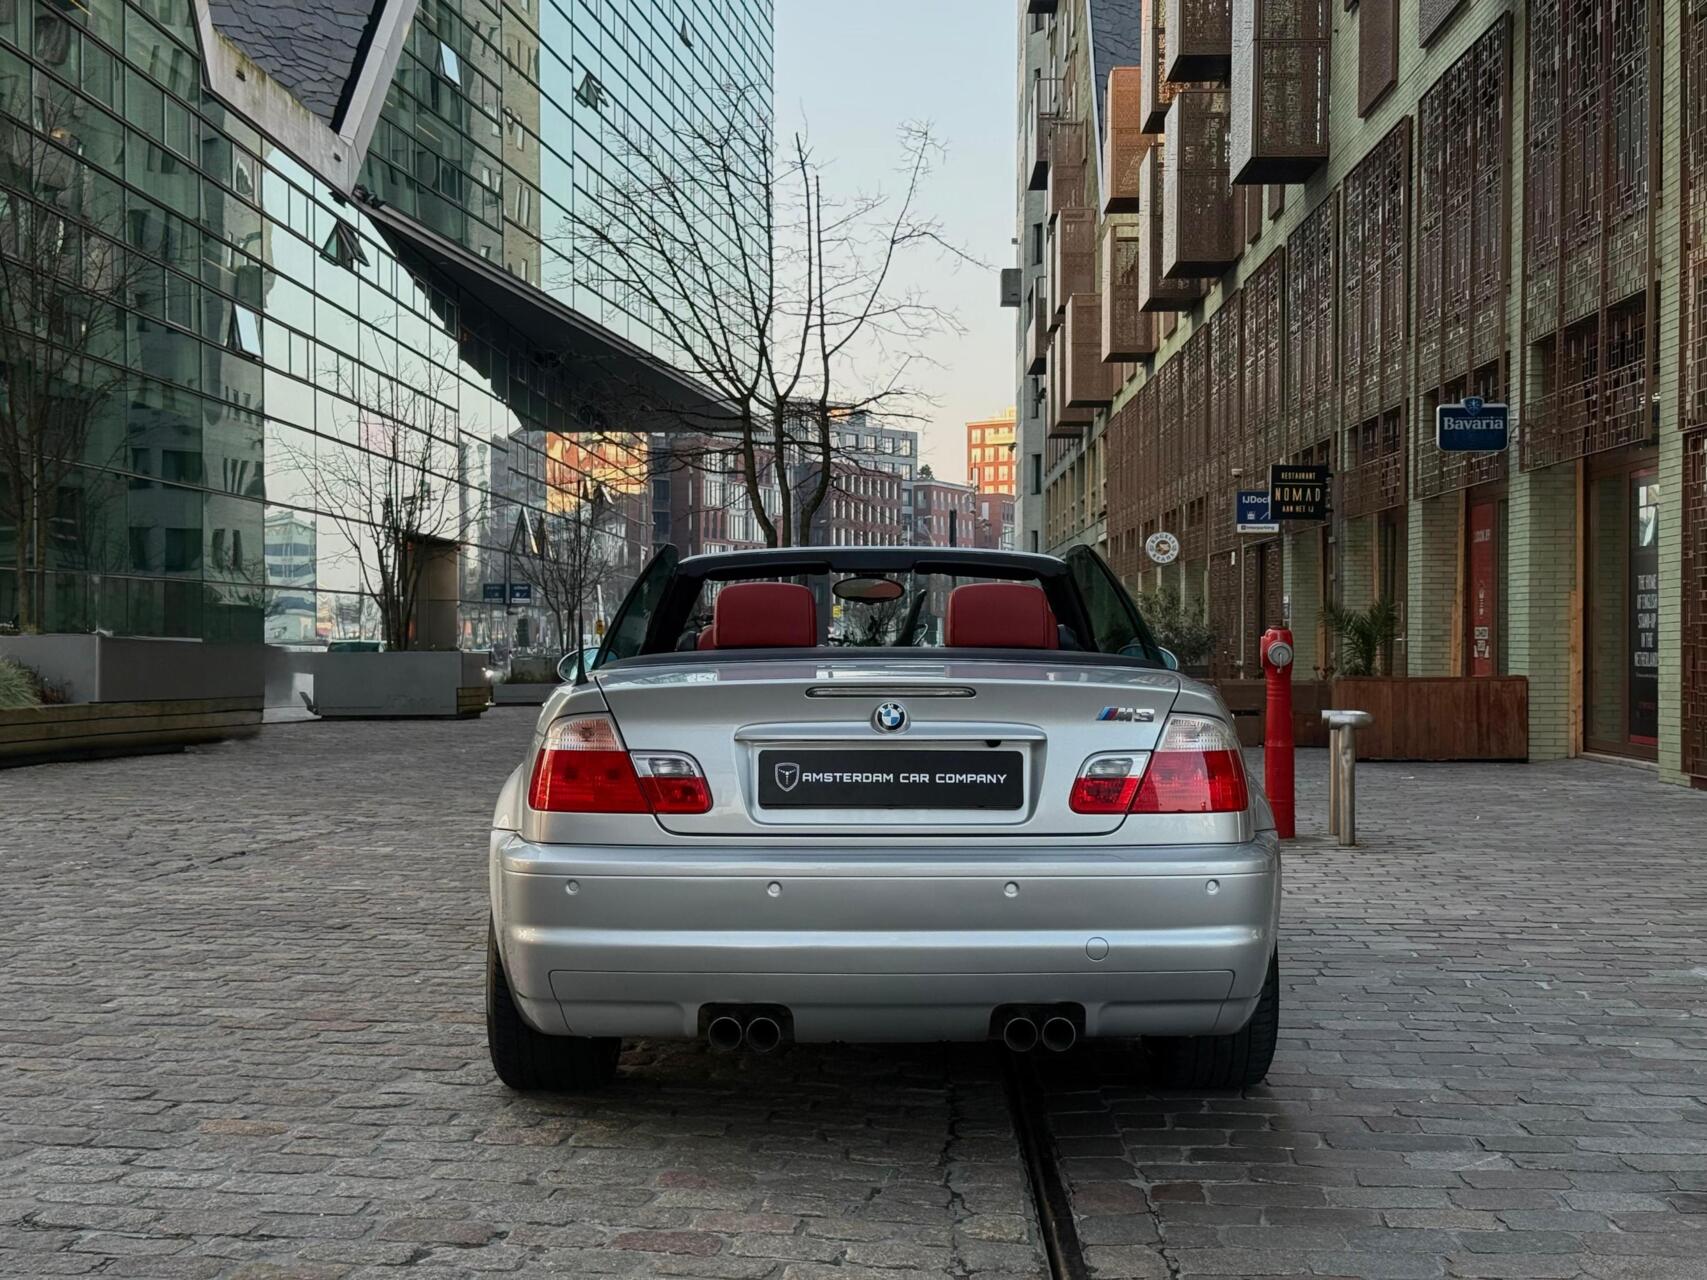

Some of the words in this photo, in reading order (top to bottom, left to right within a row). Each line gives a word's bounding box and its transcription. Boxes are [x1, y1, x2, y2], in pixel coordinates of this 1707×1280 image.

[1443, 416, 1504, 430] Bavaria
[1281, 472, 1316, 480] RESTAURANT
[1275, 487, 1321, 502] NOMAD
[1106, 707, 1155, 722] M3
[802, 772, 894, 783] AMSTERDAM
[900, 773, 930, 783] CAR
[936, 773, 1007, 784] COMPANY
